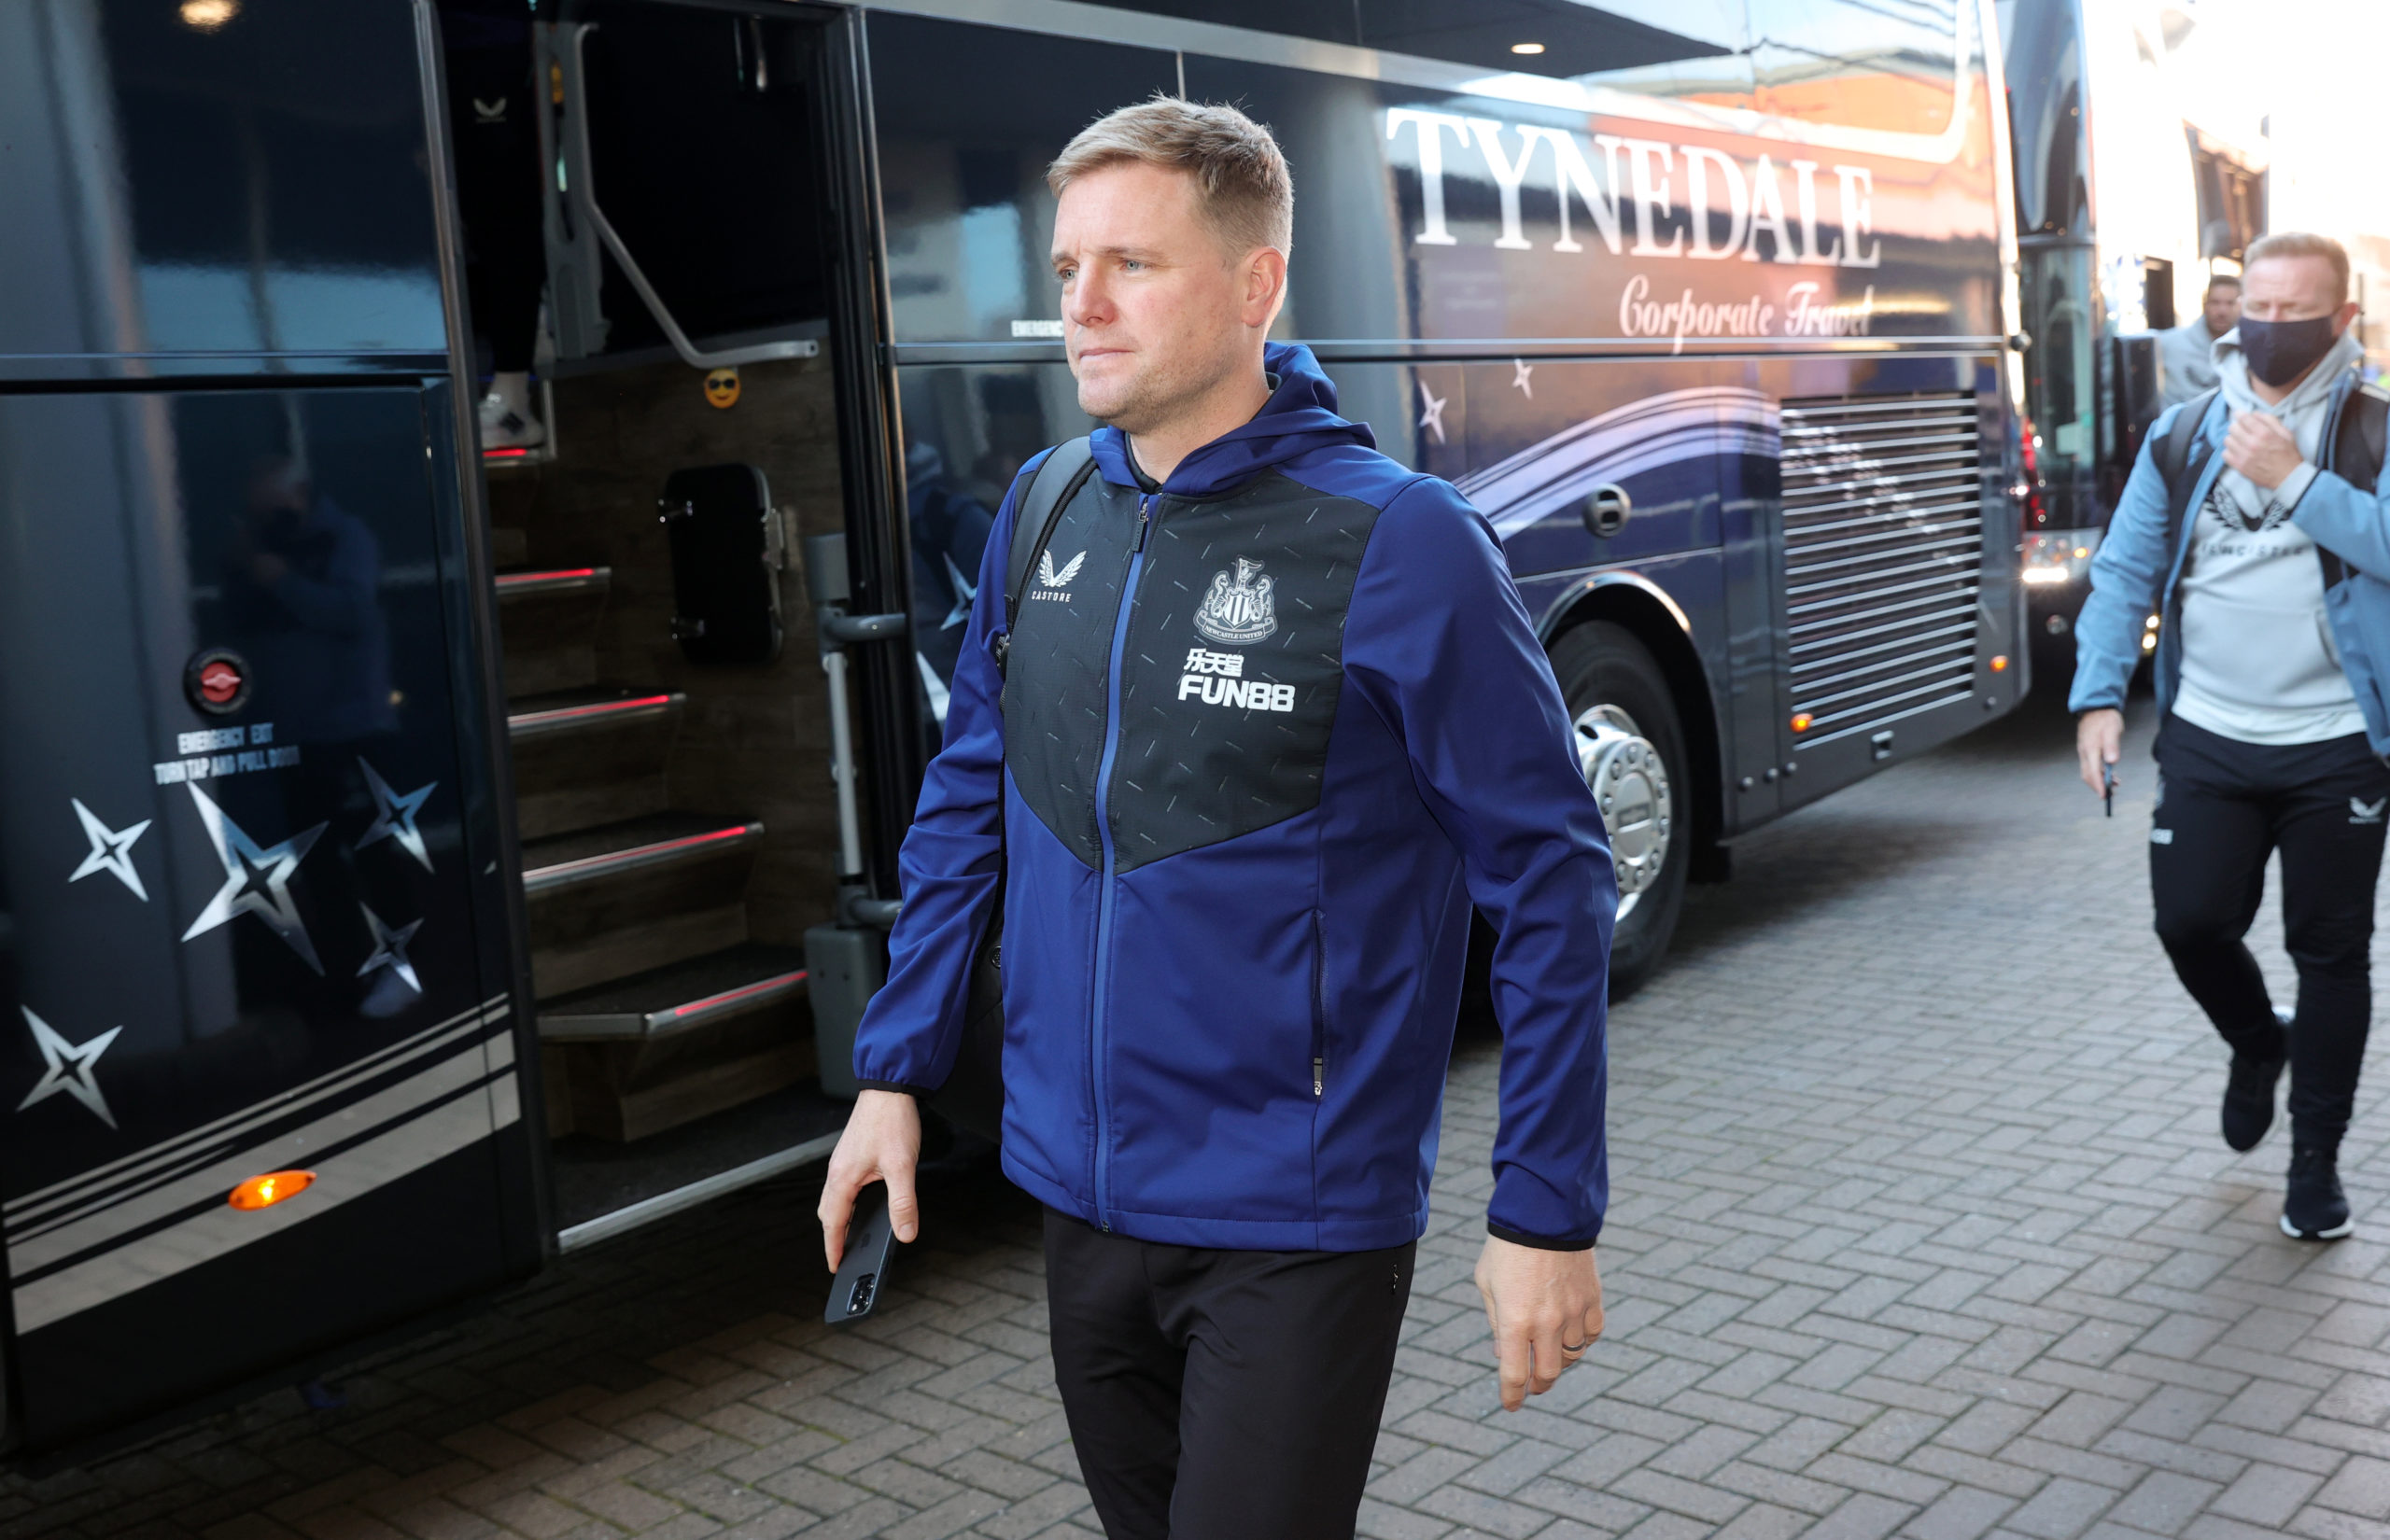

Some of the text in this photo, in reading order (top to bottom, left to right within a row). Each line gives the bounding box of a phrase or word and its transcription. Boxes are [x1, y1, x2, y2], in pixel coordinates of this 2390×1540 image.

[1386, 106, 1881, 269] TYNEDALE
[1619, 273, 1876, 355] Corporate Travel
[1031, 590, 1073, 603] CASTORE
[1204, 625, 1263, 639] NEWCASTLE UNITED
[1177, 674, 1296, 712] FUN88
